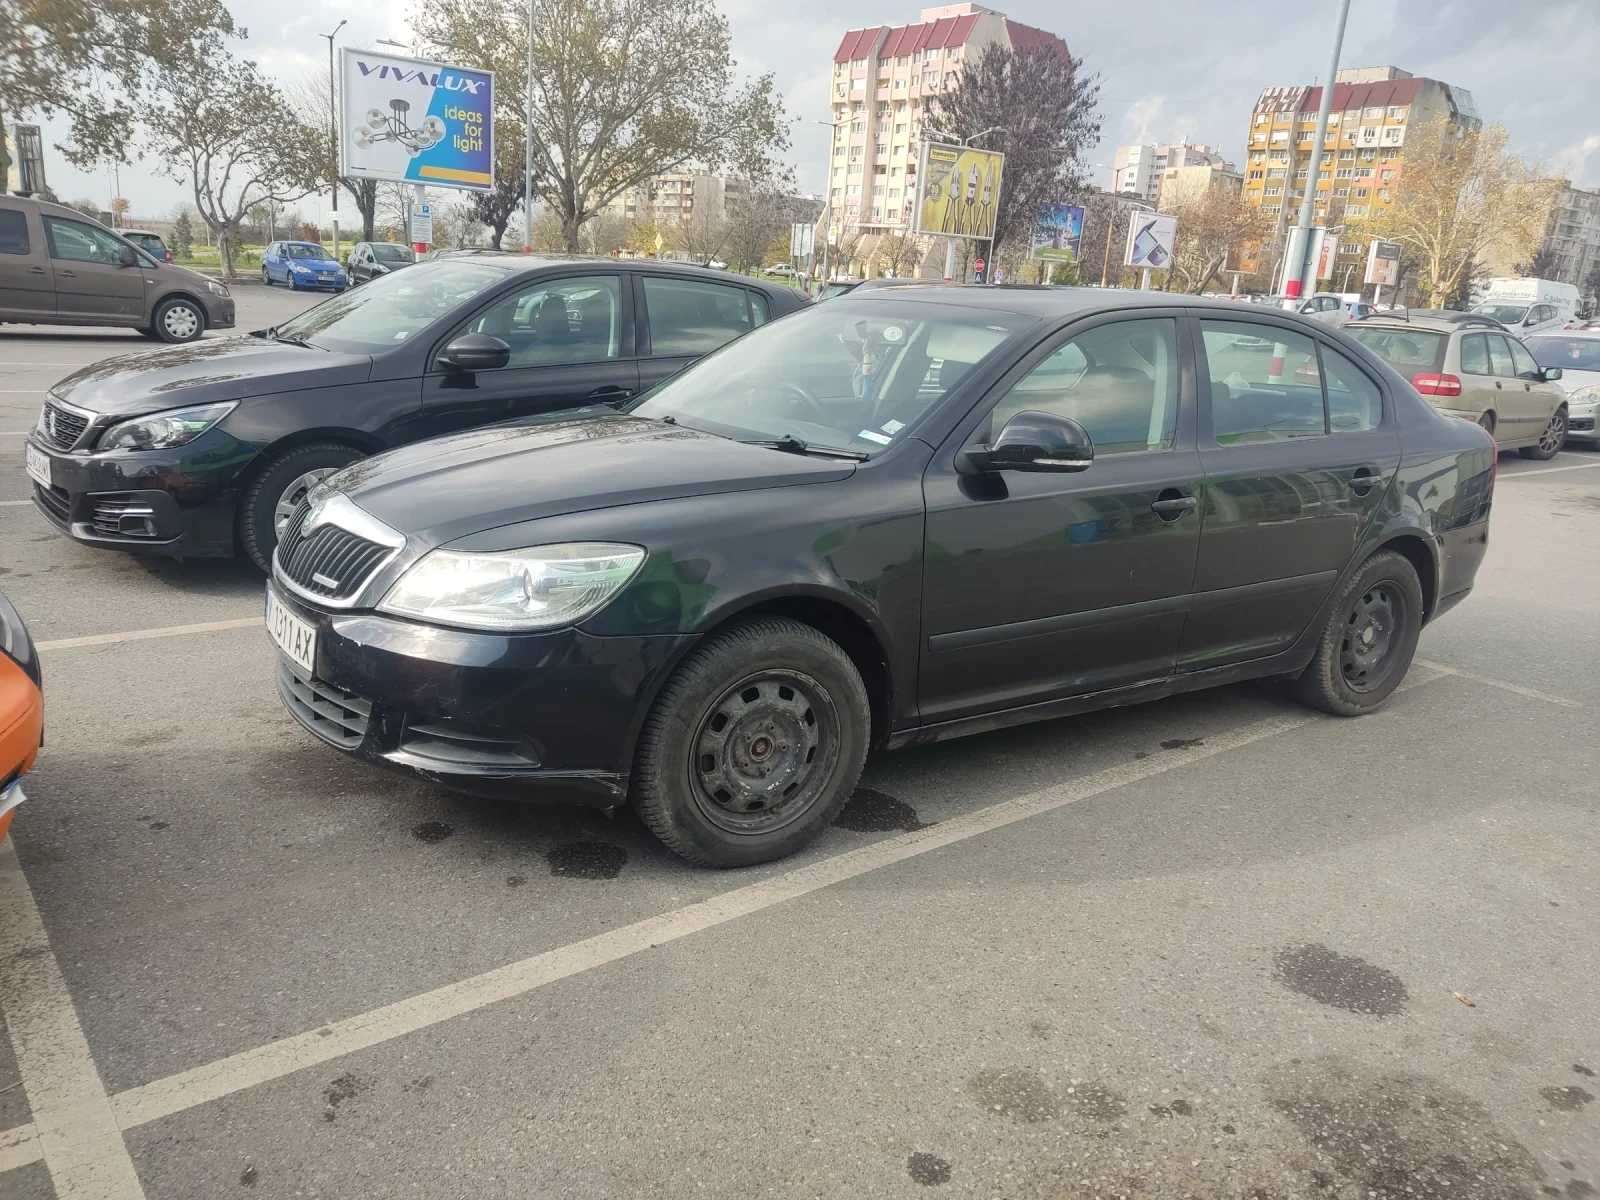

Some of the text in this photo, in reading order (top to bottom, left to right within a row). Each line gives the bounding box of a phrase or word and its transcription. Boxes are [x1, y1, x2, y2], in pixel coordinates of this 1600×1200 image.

[357, 61, 484, 94] VIVALUX
[444, 105, 482, 123] ideas
[464, 123, 482, 137] for
[453, 134, 482, 152] light
[932, 150, 956, 158] topmaster
[294, 625, 313, 665] AX
